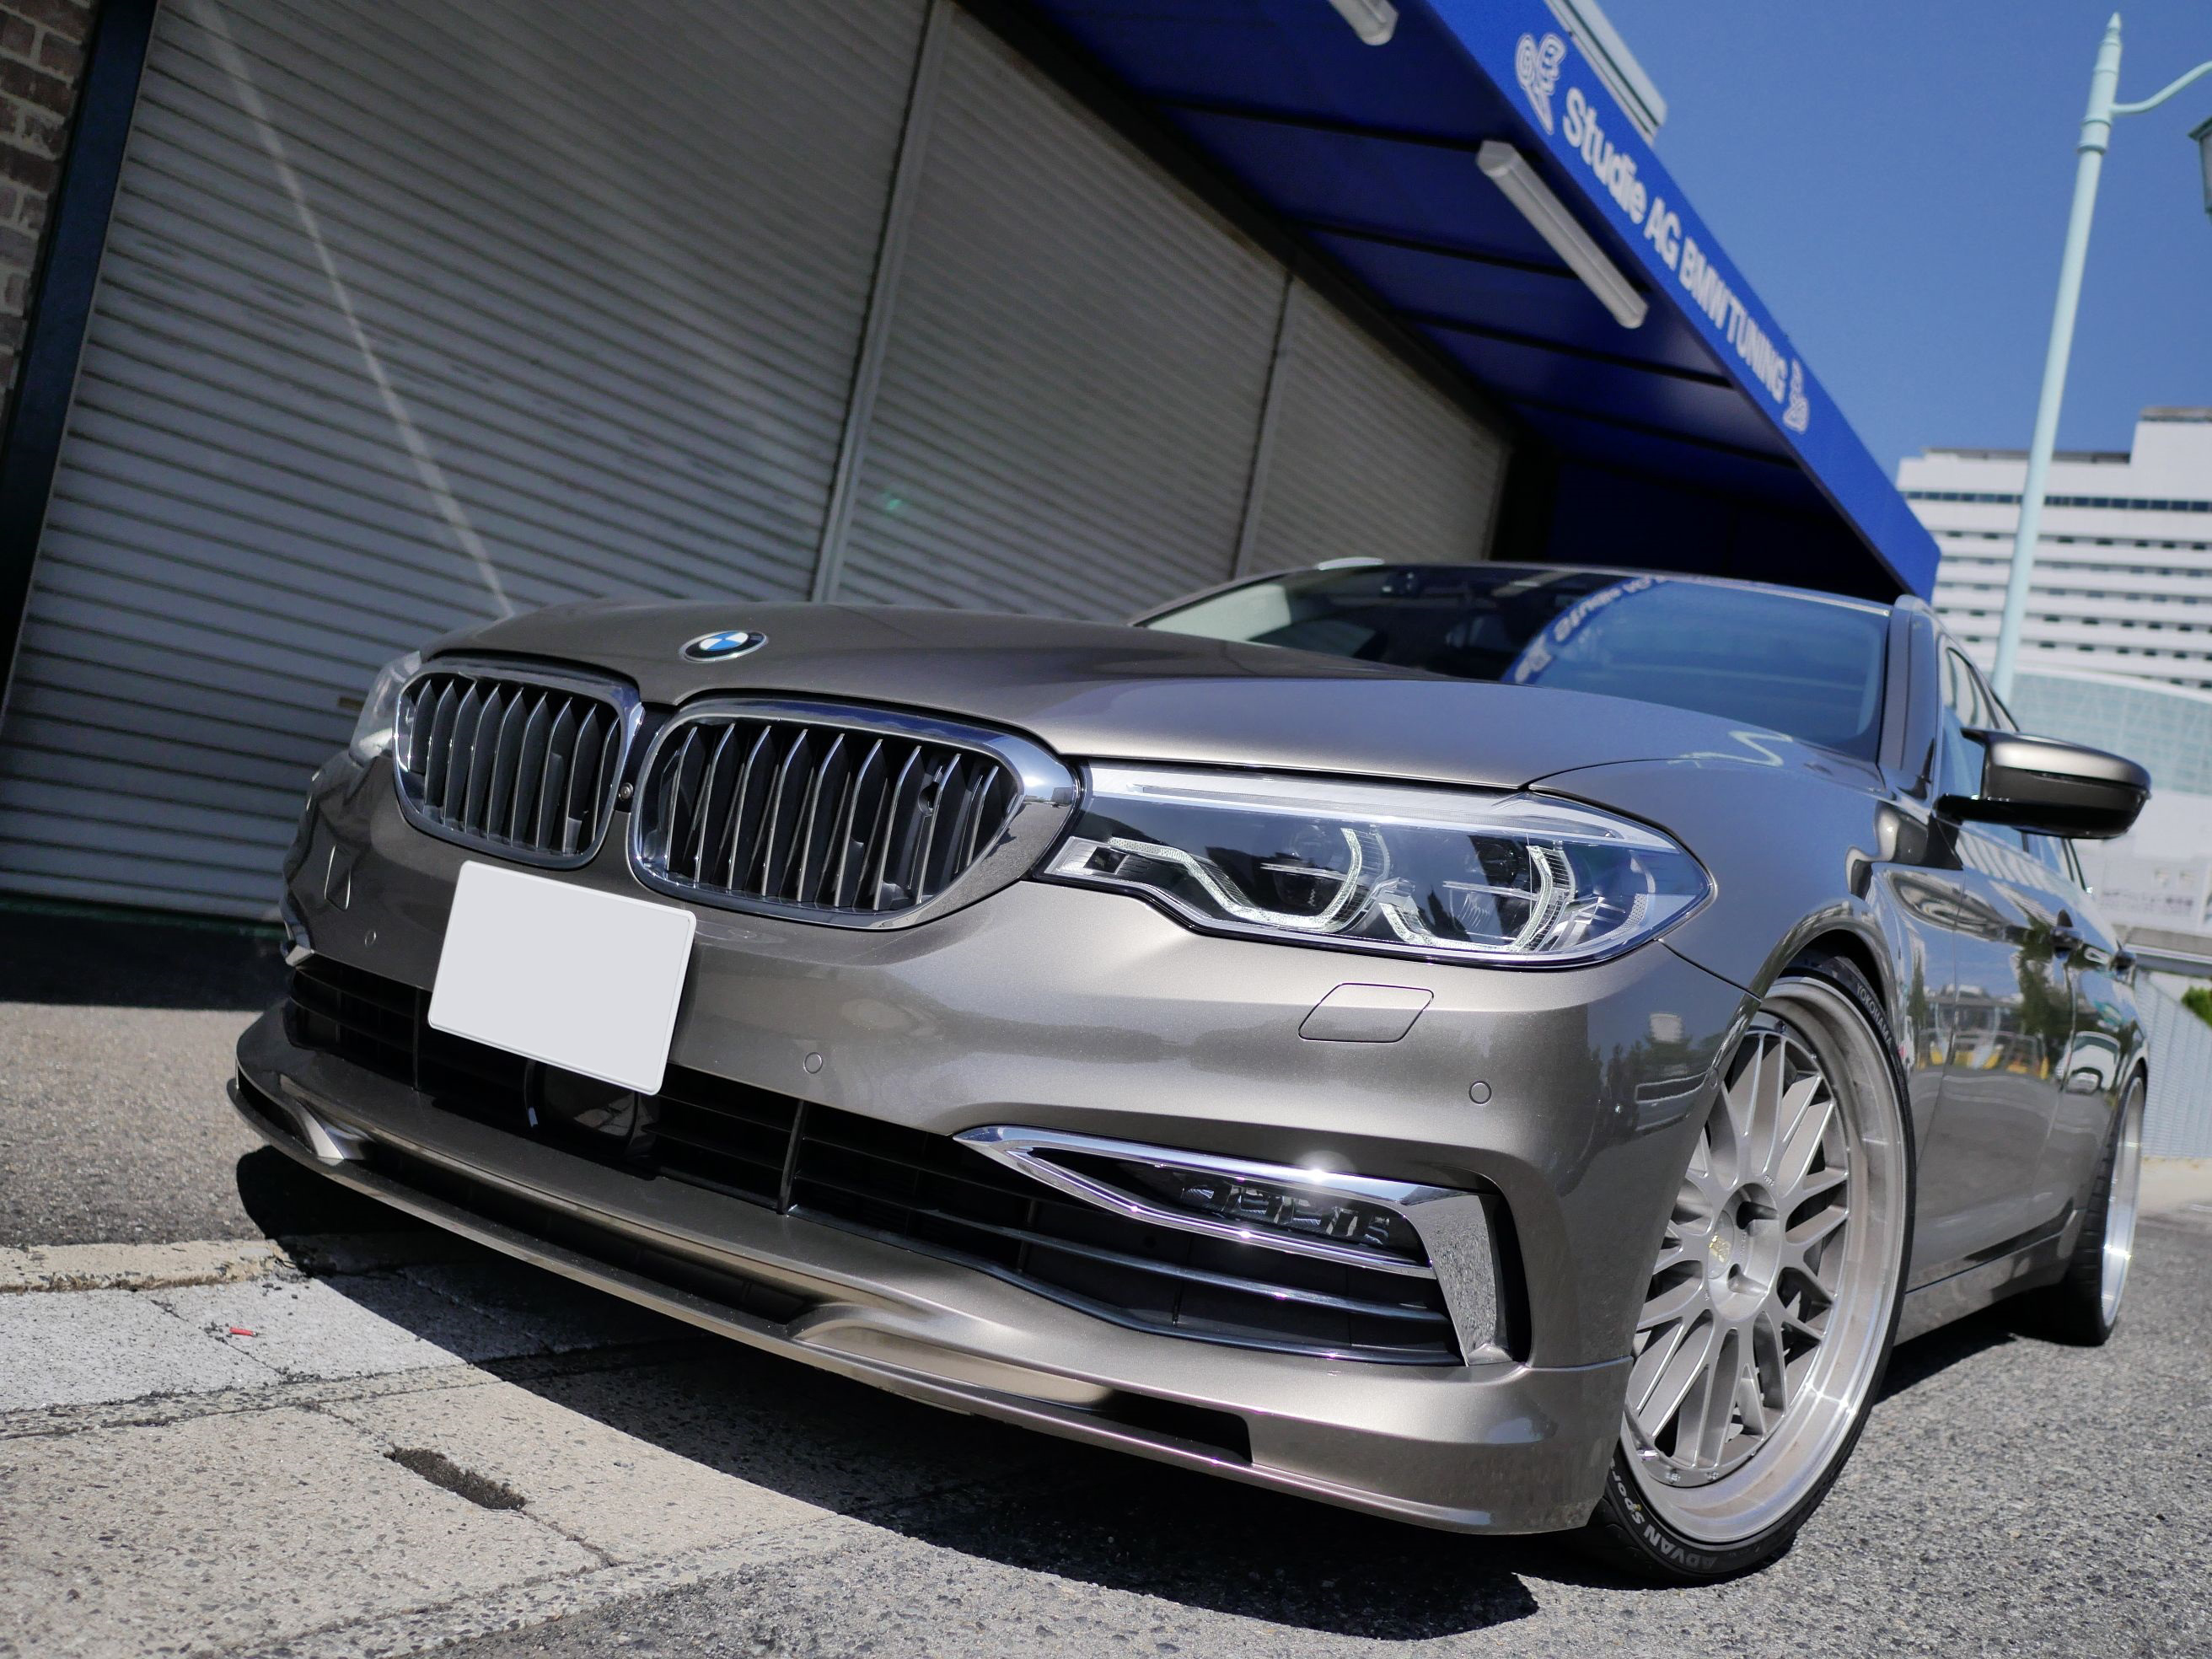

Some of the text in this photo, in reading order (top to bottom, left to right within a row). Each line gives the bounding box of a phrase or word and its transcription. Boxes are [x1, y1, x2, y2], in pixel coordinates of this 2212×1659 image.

[1563, 87, 1647, 224] Studie
[1645, 196, 1682, 271] AG
[1856, 983, 1893, 1047] YOKOHAMA
[1644, 1524, 1718, 1568] ADVAN
